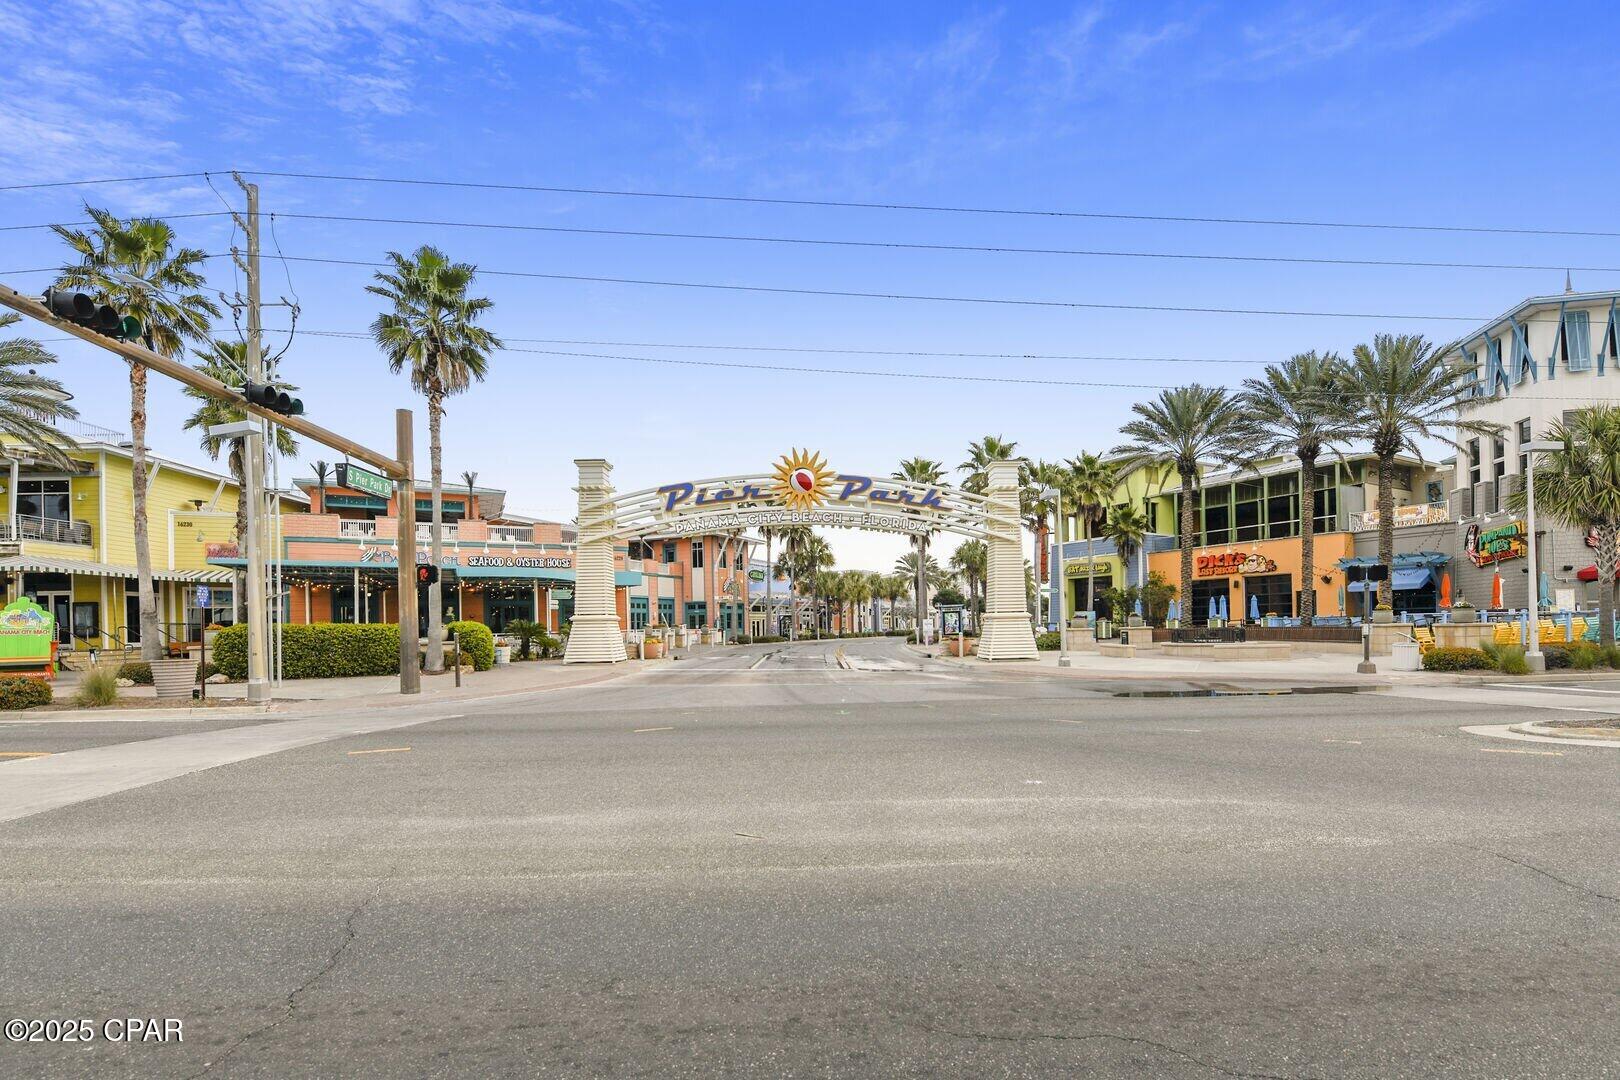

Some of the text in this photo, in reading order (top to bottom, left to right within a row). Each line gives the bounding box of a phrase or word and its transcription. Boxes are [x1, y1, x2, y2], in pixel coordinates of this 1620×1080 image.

[348, 470, 391, 495] S Pier Park Dr
[657, 474, 953, 512] Pier Park
[675, 512, 928, 534] PANAMA CITY BEACH FLORIDA
[468, 556, 571, 568] SEAFOOD & OYSTER HOUSE
[1197, 552, 1247, 569] DICK'S
[1199, 565, 1237, 577] LAST RESORT
